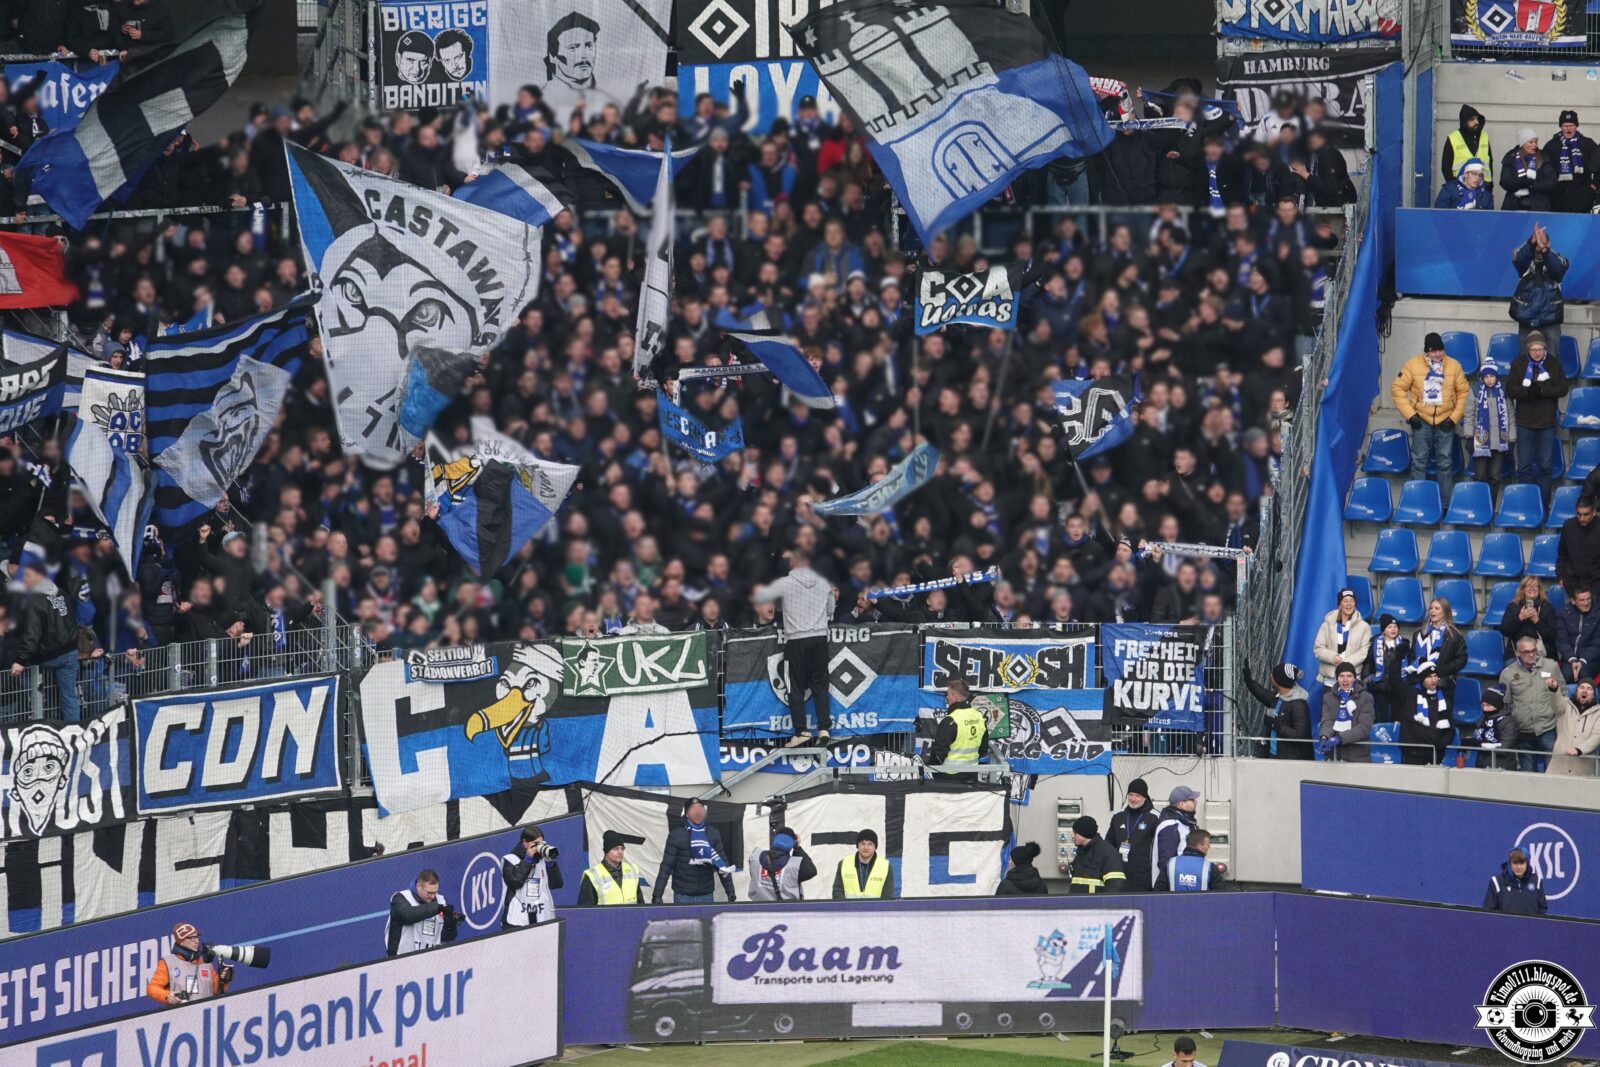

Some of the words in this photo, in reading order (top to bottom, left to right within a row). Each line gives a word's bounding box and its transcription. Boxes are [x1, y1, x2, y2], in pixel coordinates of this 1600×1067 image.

[381, 2, 487, 31] BIERIGE
[1243, 56, 1331, 75] HAMBURG
[384, 81, 487, 110] BANDITEN
[427, 645, 472, 663] SEKTION
[615, 637, 707, 685] UKL
[1114, 639, 1200, 662] FREIHEIT
[410, 659, 493, 680] STADIONVERBOT
[1123, 657, 1160, 681] FÜR
[1163, 661, 1196, 682] DIE
[1113, 678, 1203, 713] KURVE
[144, 685, 330, 794] CDN
[1050, 737, 1106, 761] SÜD
[1529, 841, 1565, 879] KSC
[471, 866, 496, 914] KSC
[727, 924, 902, 981] Baam
[754, 976, 813, 986] Transporte
[816, 974, 837, 984] und
[841, 972, 894, 984] Lagerung
[136, 972, 382, 1067] Volksbank
[394, 967, 474, 1048] pur
